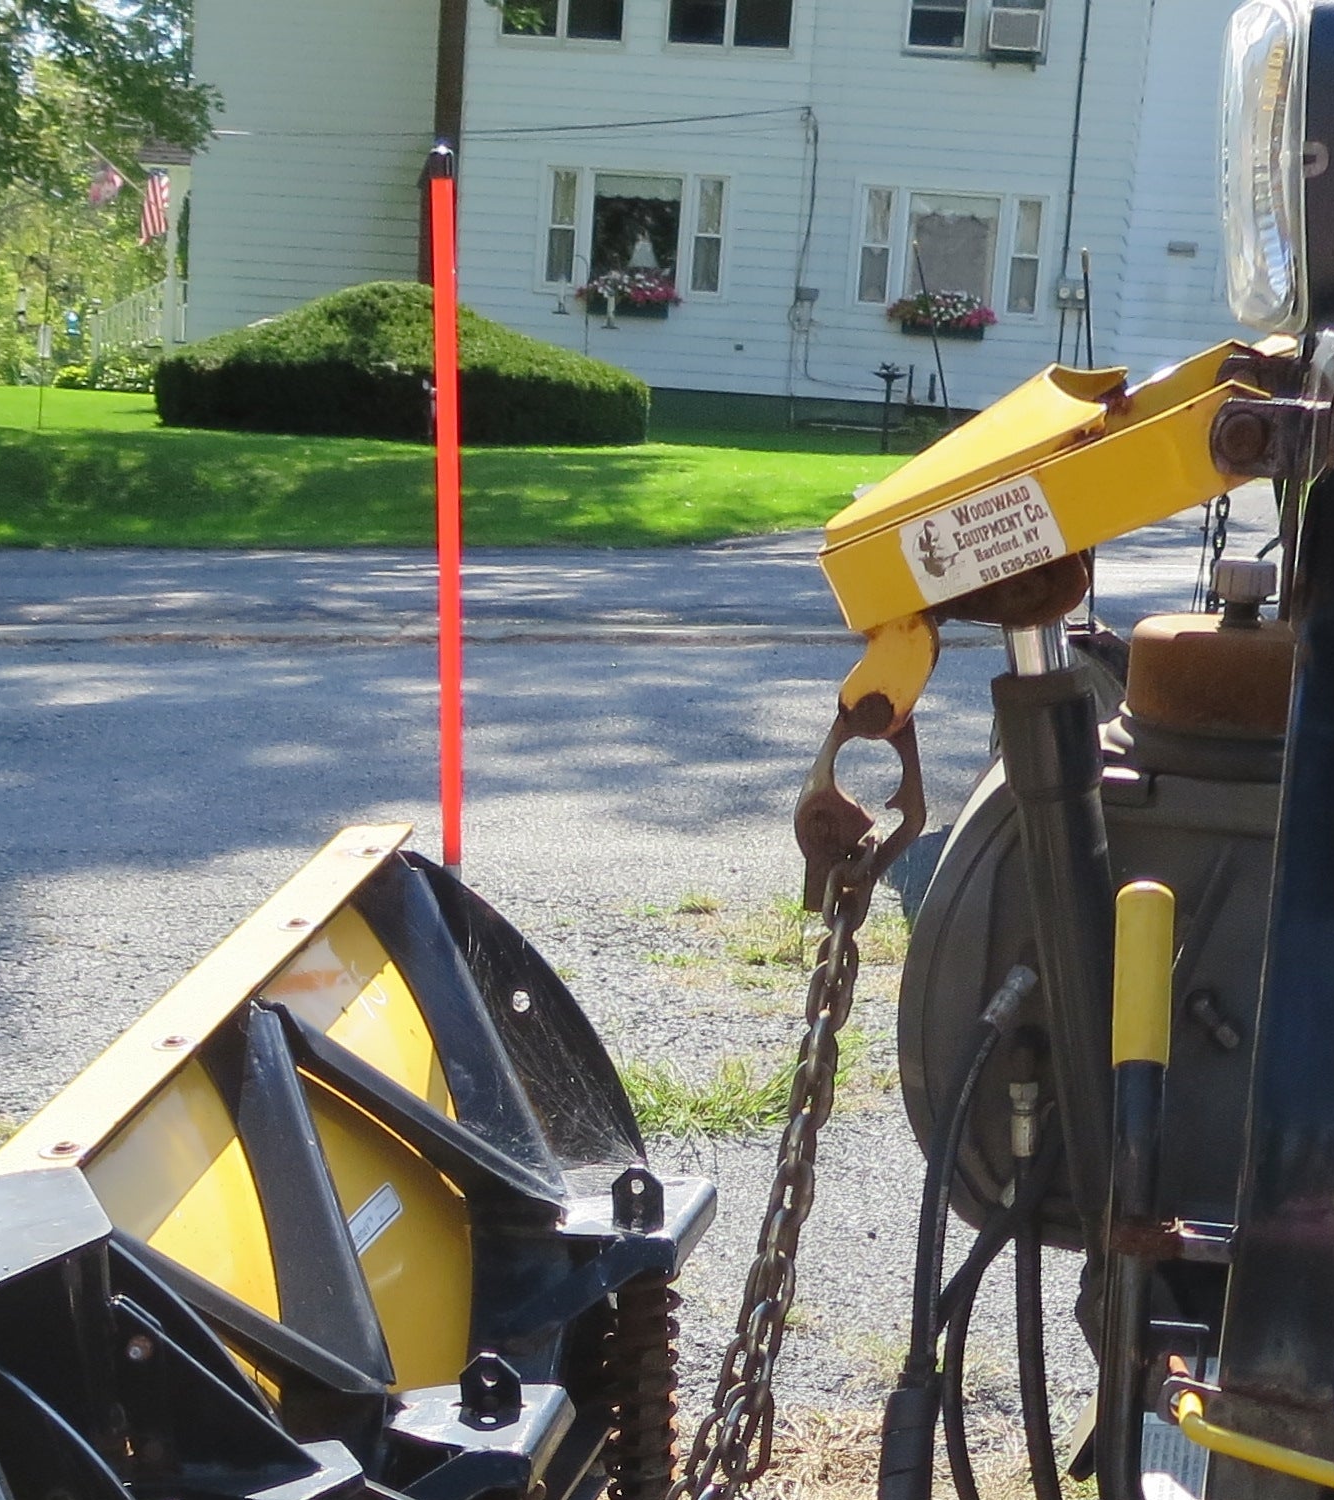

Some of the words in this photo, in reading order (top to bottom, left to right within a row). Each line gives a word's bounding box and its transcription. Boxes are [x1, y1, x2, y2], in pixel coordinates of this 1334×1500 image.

[951, 485, 1030, 526] WOODWARD
[952, 513, 1023, 551] EQUIPMENT
[1024, 502, 1049, 524] Co.
[1025, 527, 1041, 545] NY
[979, 565, 1000, 583] 518
